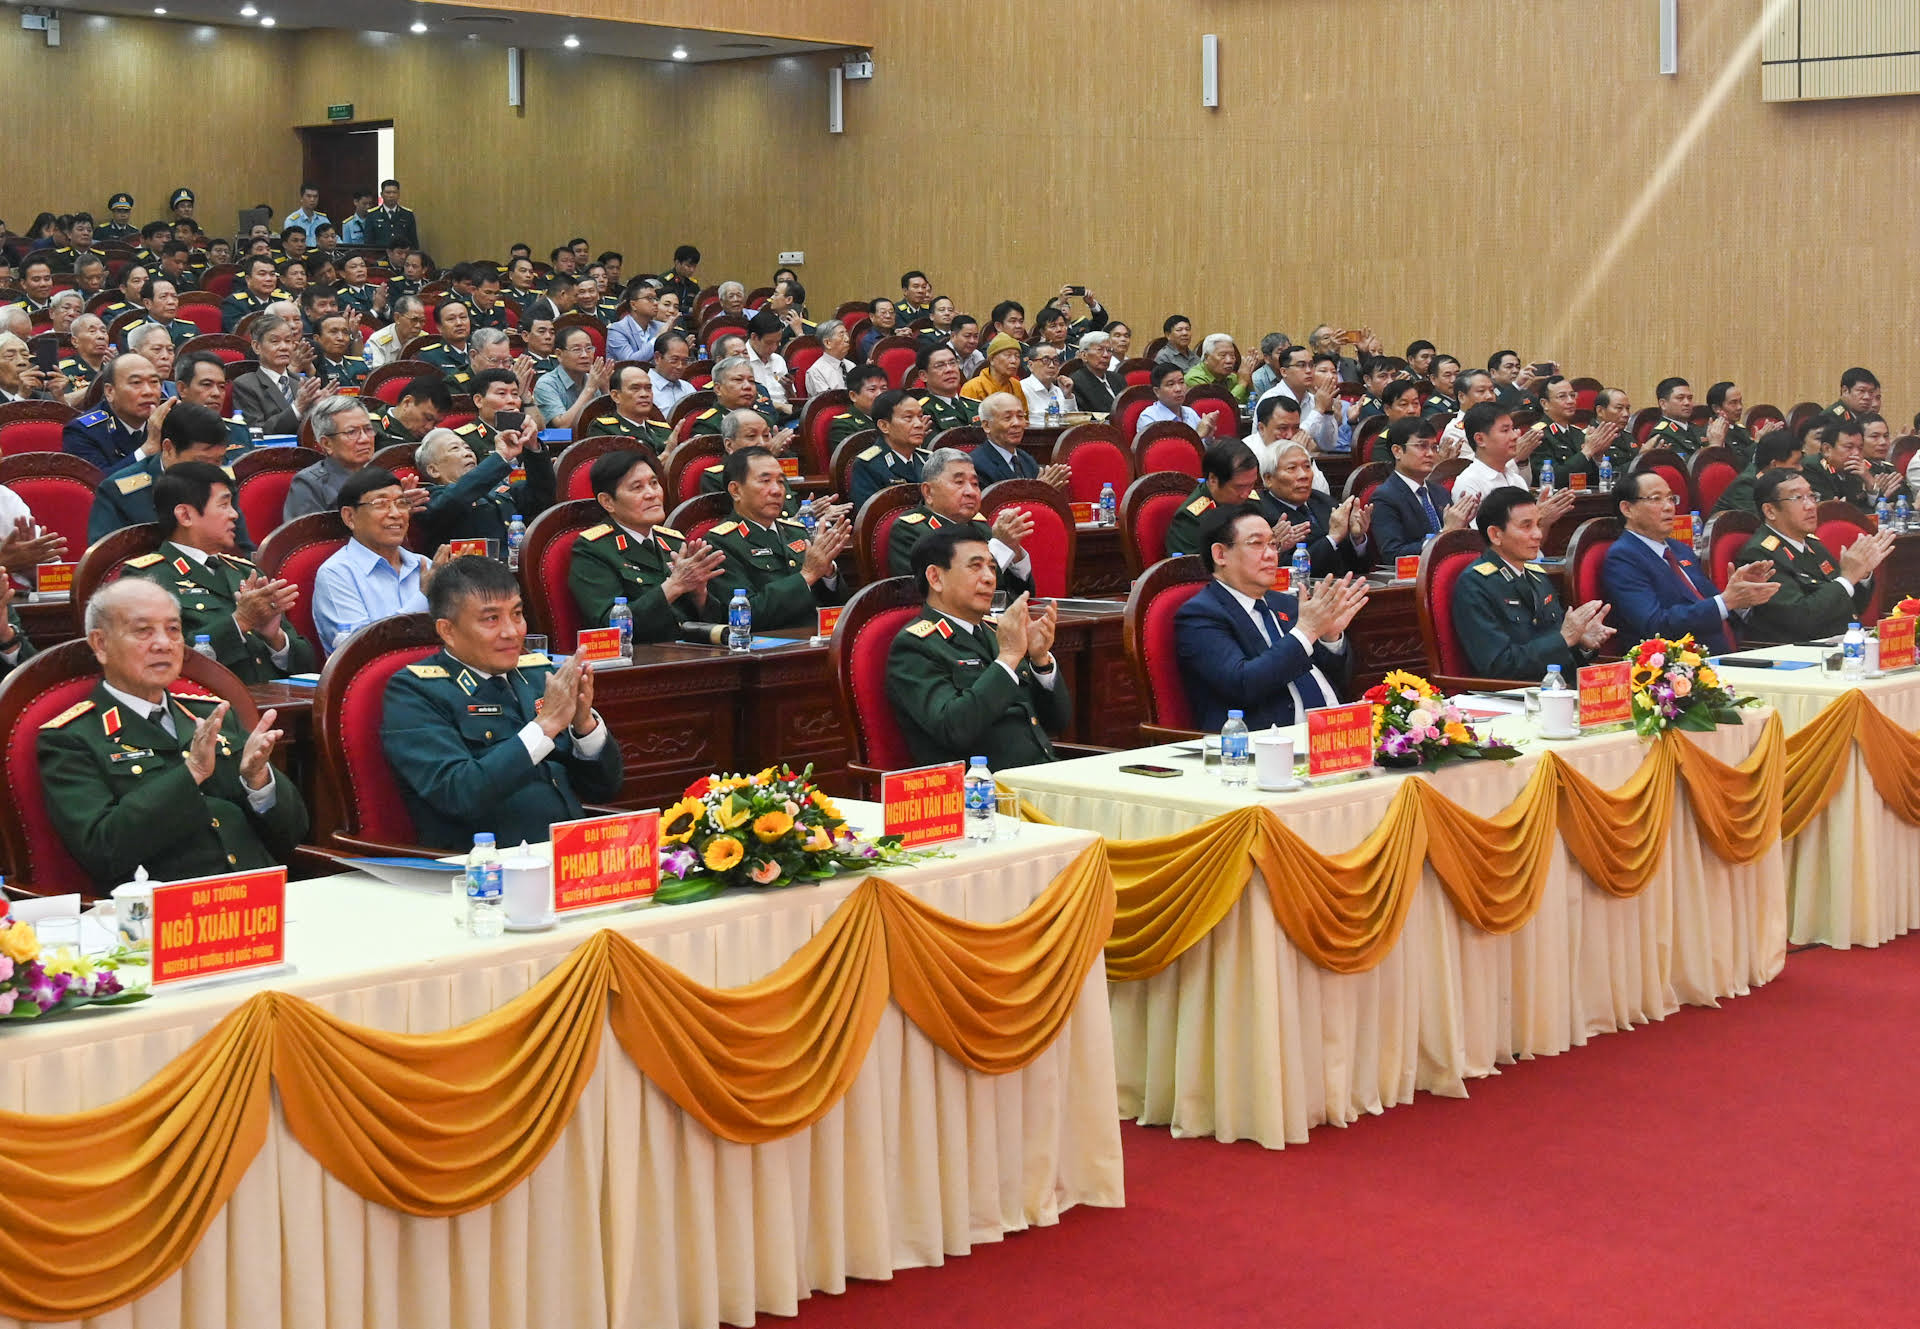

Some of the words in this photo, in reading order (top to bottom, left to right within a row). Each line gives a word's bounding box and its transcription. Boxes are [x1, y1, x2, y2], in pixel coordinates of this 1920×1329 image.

[903, 778, 925, 792] TRUNG
[926, 773, 946, 787] TƯỚNG
[886, 792, 922, 824] NGUYỄN
[924, 792, 941, 818] VĂN
[584, 829, 599, 844] ĐẠI
[600, 823, 628, 839] TƯỚNG
[561, 851, 599, 884] PHẠM
[602, 844, 626, 873] VĂN
[192, 890, 210, 908] ĐẠI
[212, 883, 247, 904] TƯỚNG
[161, 912, 193, 950] NGÔ
[197, 907, 240, 944] XUÂN
[244, 905, 277, 942] LỊCH
